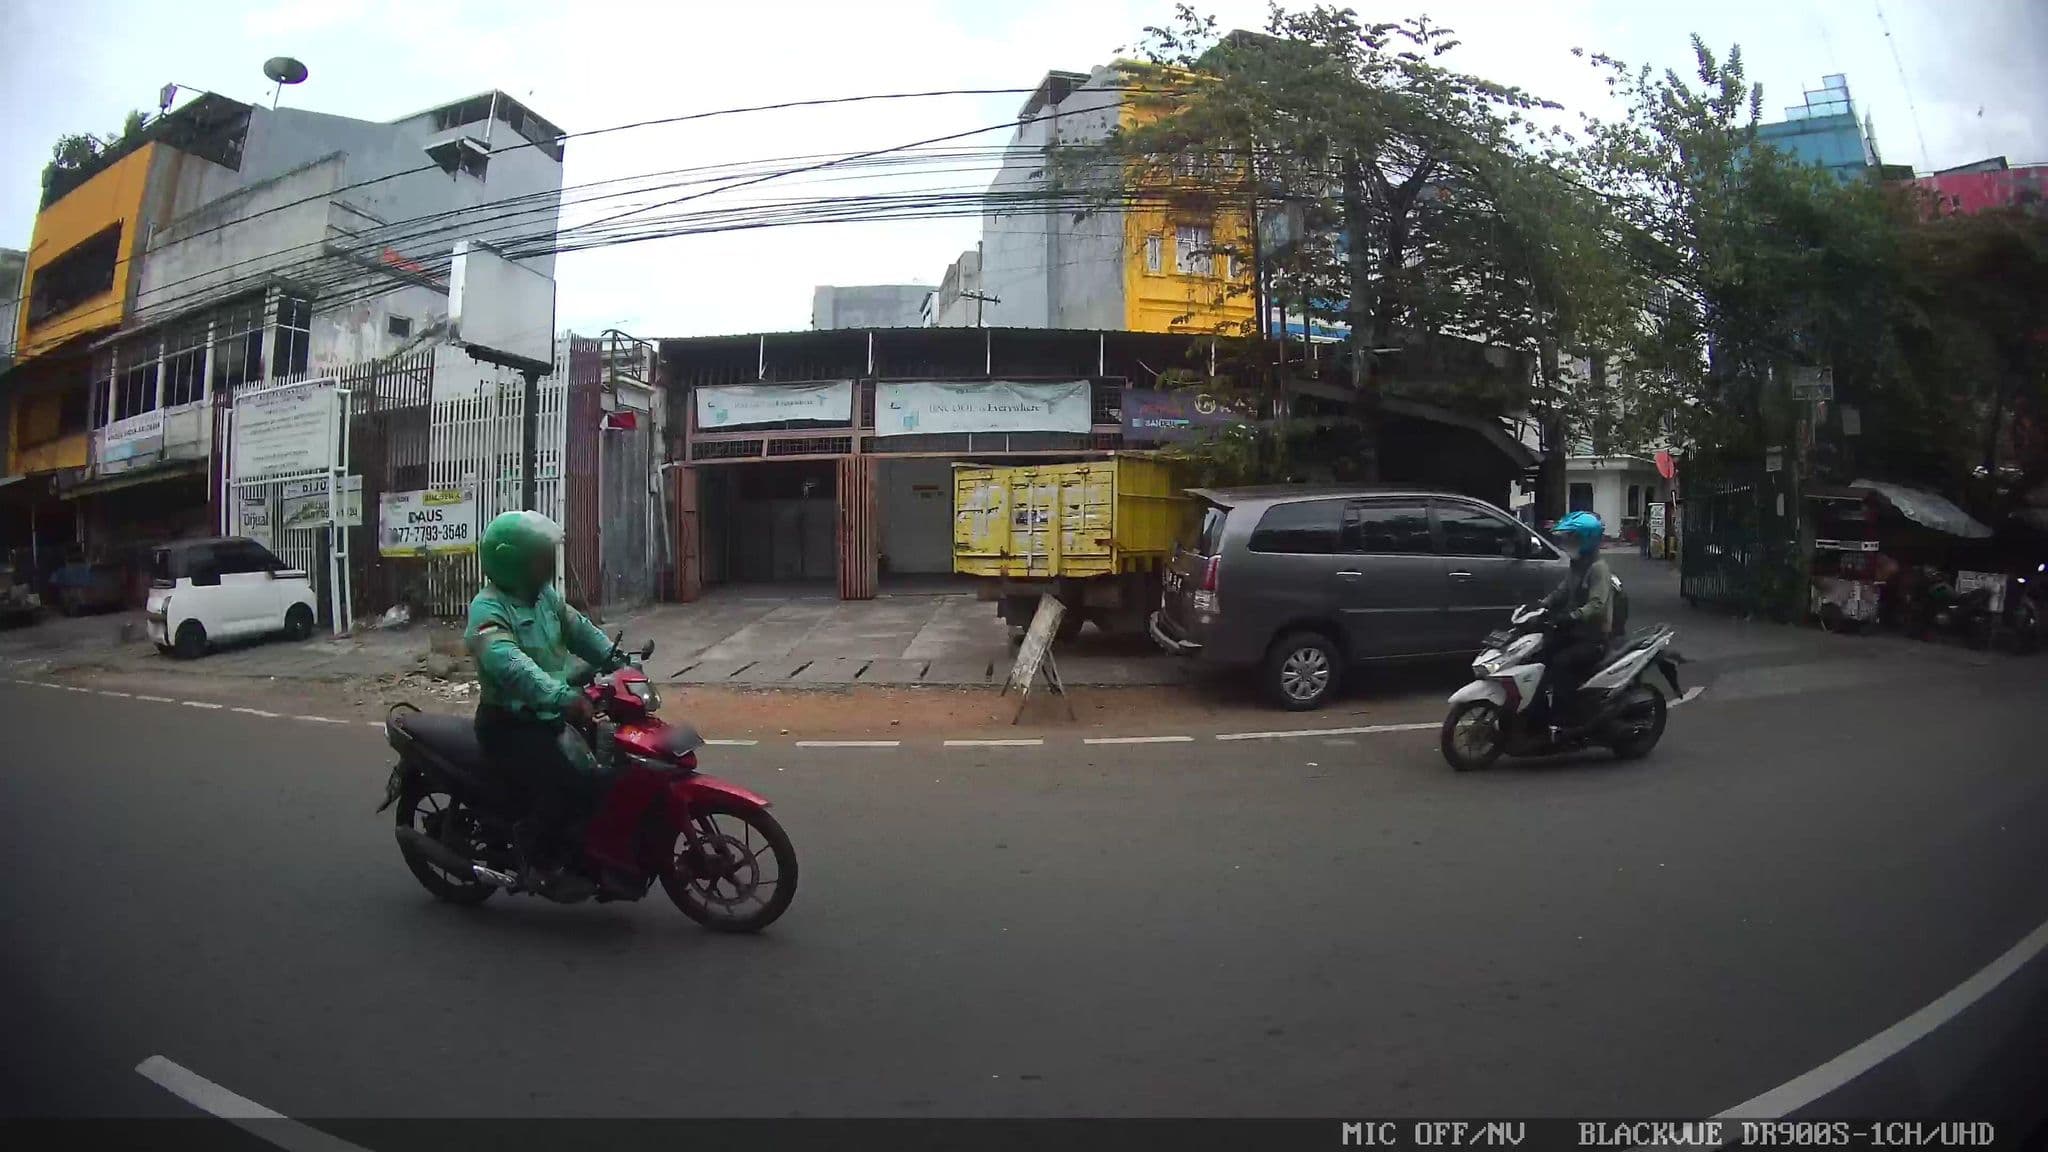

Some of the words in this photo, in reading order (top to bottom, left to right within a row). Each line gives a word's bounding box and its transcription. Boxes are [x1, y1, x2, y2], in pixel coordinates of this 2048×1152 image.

[303, 479, 342, 493] DIJUL
[408, 509, 443, 524] DAUS
[389, 523, 468, 543] 77-7793-3548
